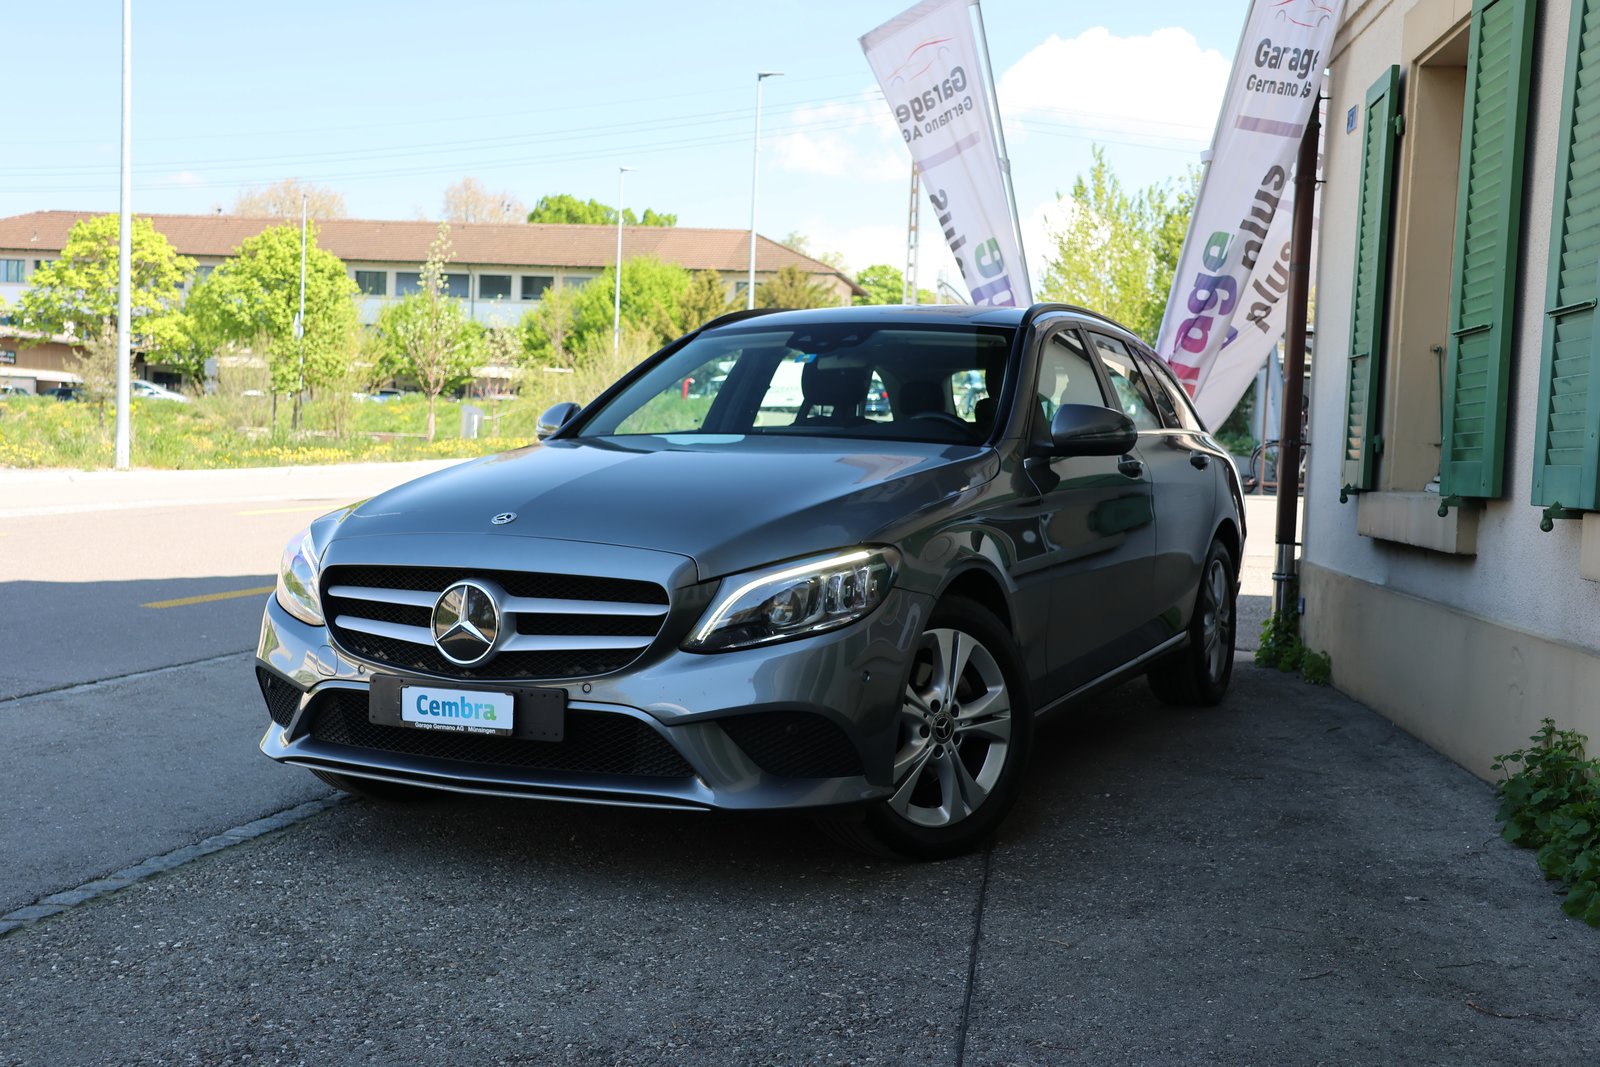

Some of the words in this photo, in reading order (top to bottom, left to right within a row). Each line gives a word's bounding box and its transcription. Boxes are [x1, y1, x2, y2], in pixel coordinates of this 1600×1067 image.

[1168, 231, 1238, 398] rage
[416, 694, 497, 721] Cembra
[414, 721, 432, 730] Garage
[433, 723, 456, 731] Germano
